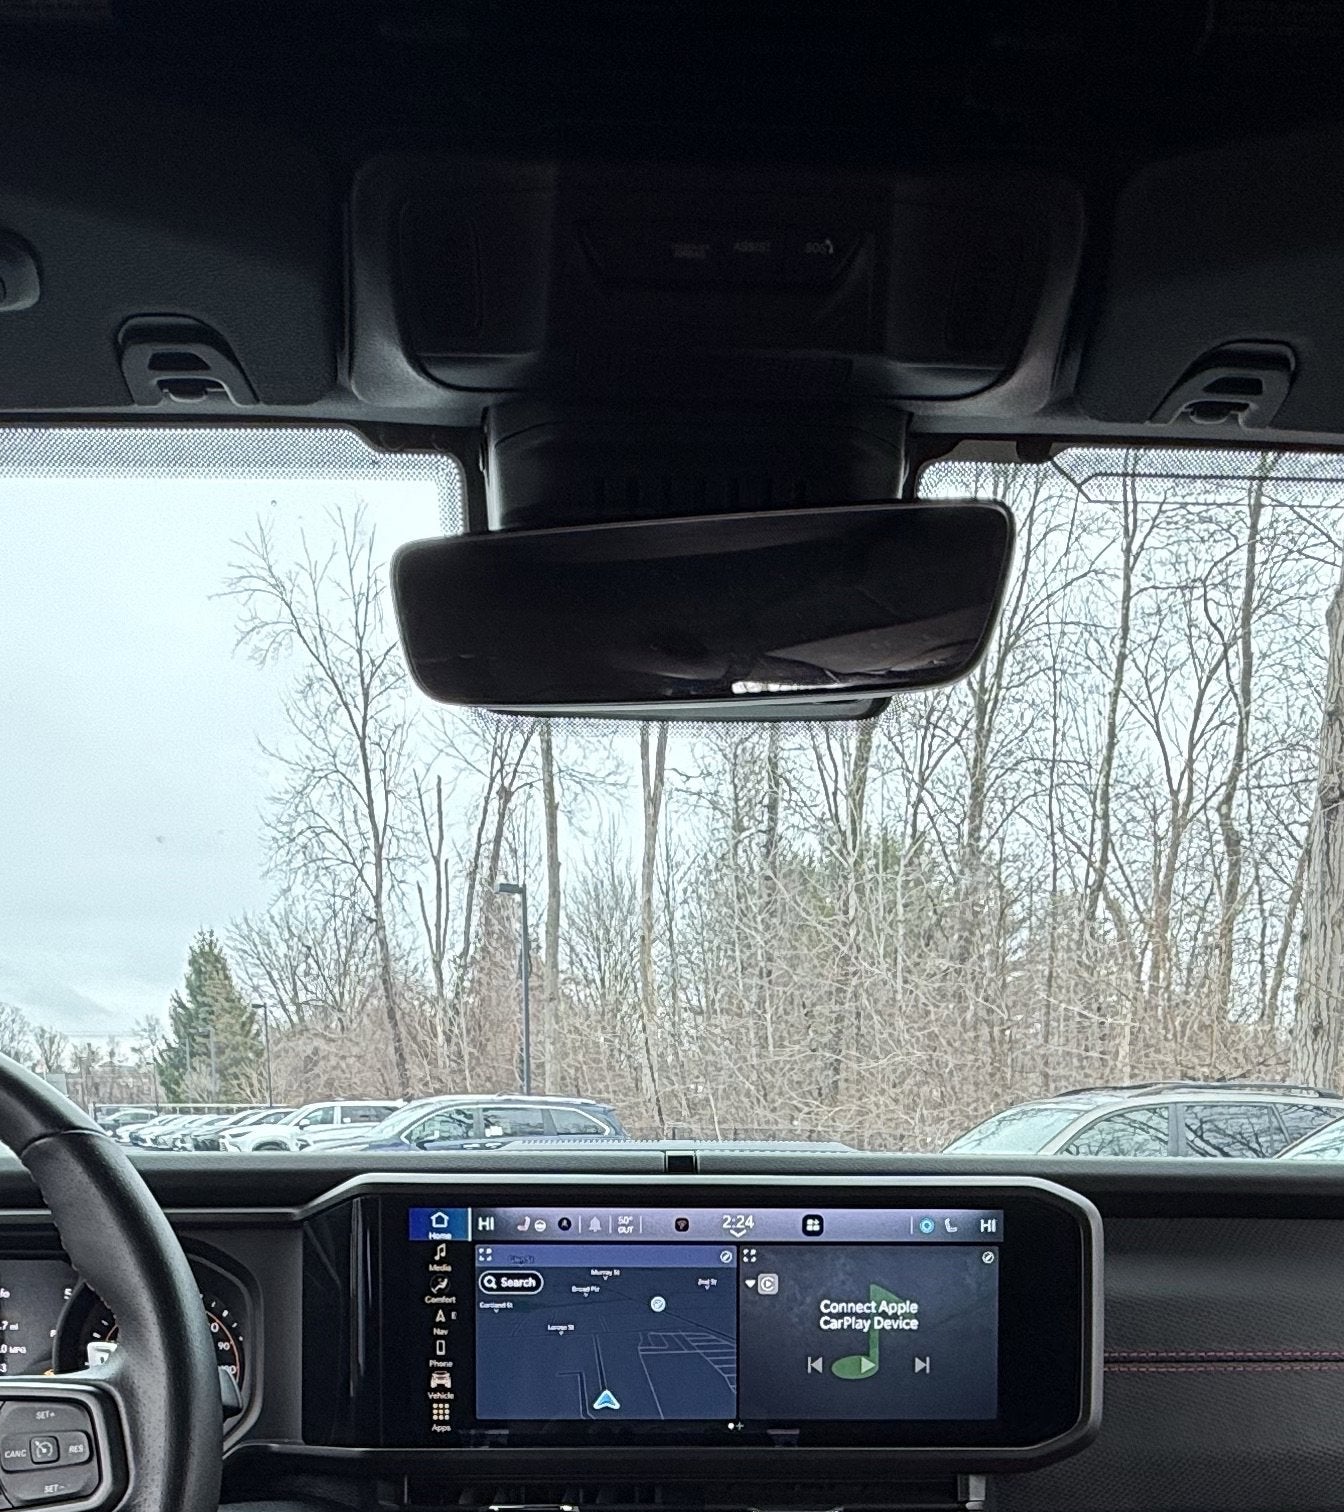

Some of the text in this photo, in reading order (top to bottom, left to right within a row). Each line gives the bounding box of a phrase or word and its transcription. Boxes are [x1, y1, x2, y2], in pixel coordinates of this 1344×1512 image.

[477, 1216, 495, 1231] HI
[721, 1214, 754, 1229] 2:24
[979, 1218, 997, 1233] HI
[428, 1231, 452, 1240] Home
[428, 1263, 452, 1272] Media
[500, 1276, 536, 1288] Search
[424, 1295, 456, 1304] Comfort
[819, 1299, 919, 1317] Connect Apple
[9, 1322, 19, 1331] mi
[819, 1316, 919, 1332] CarPlay Device
[432, 1327, 449, 1336] Nav
[217, 1342, 230, 1351] 90
[428, 1359, 453, 1368] Phone
[426, 1391, 455, 1400] Vehicle
[35, 1410, 56, 1420] SET+
[431, 1424, 452, 1433] Apps
[4, 1444, 84, 1459] CANC RES
